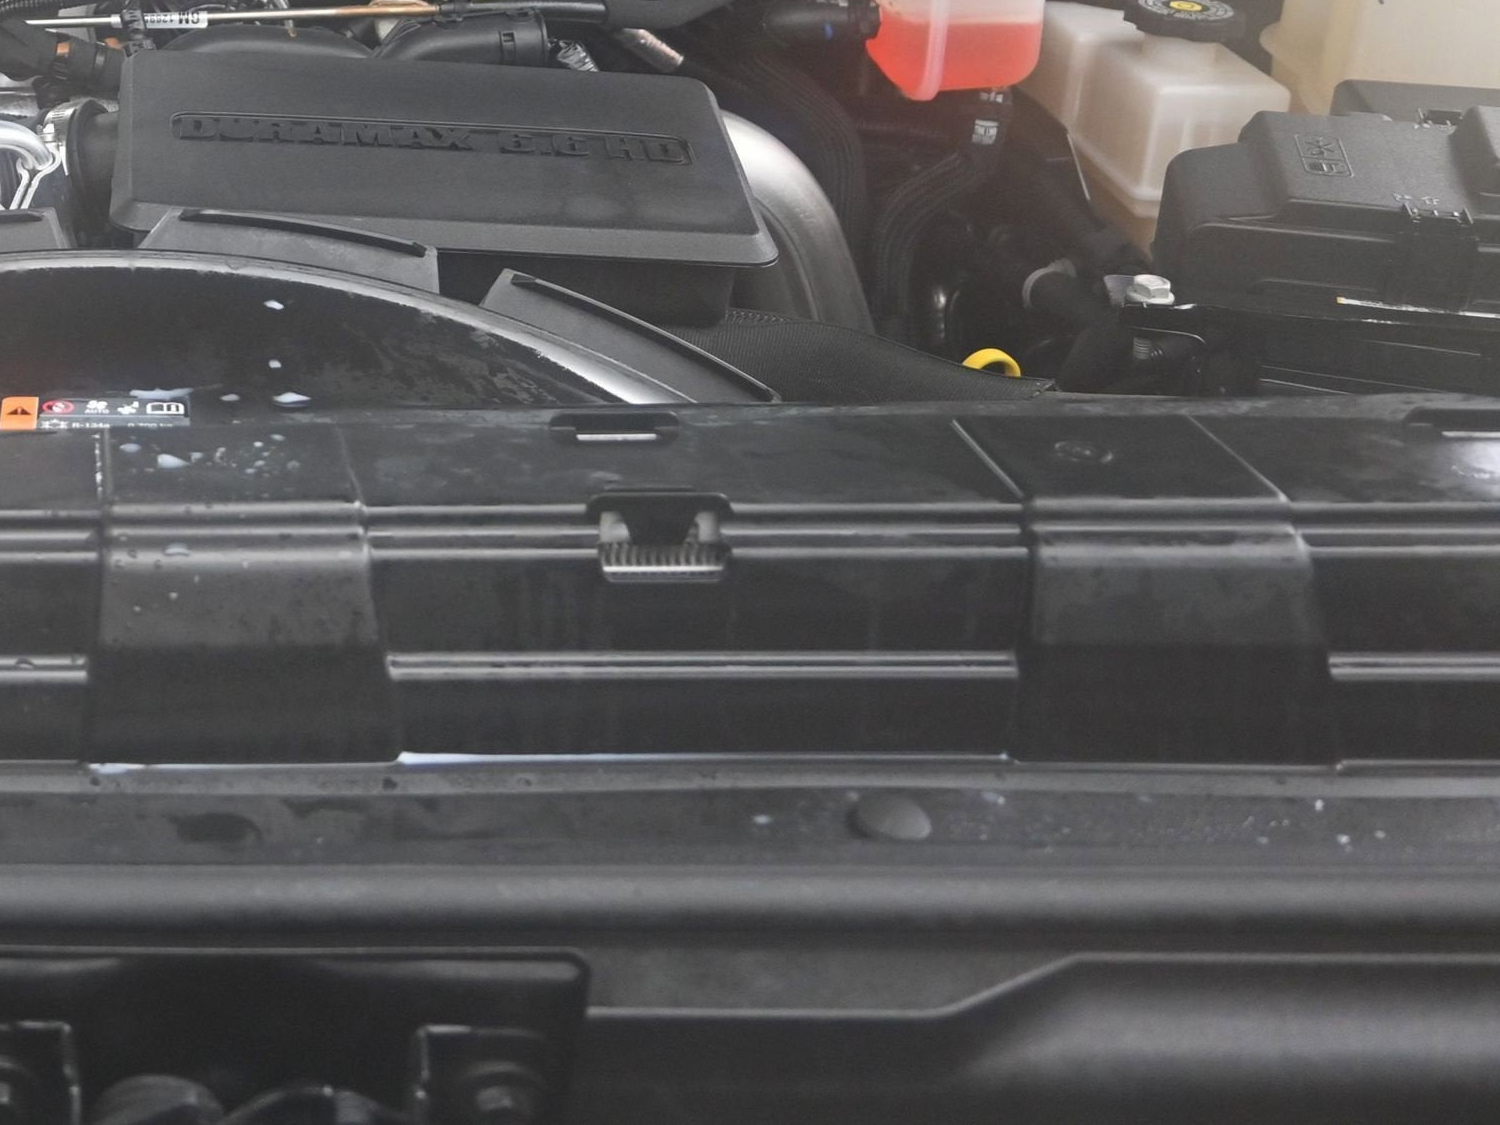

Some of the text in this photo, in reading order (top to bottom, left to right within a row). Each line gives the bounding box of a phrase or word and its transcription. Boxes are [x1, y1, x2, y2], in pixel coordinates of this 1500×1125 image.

[178, 10, 200, 25] GM
[178, 117, 687, 163] DURAMAX 6.6 HD
